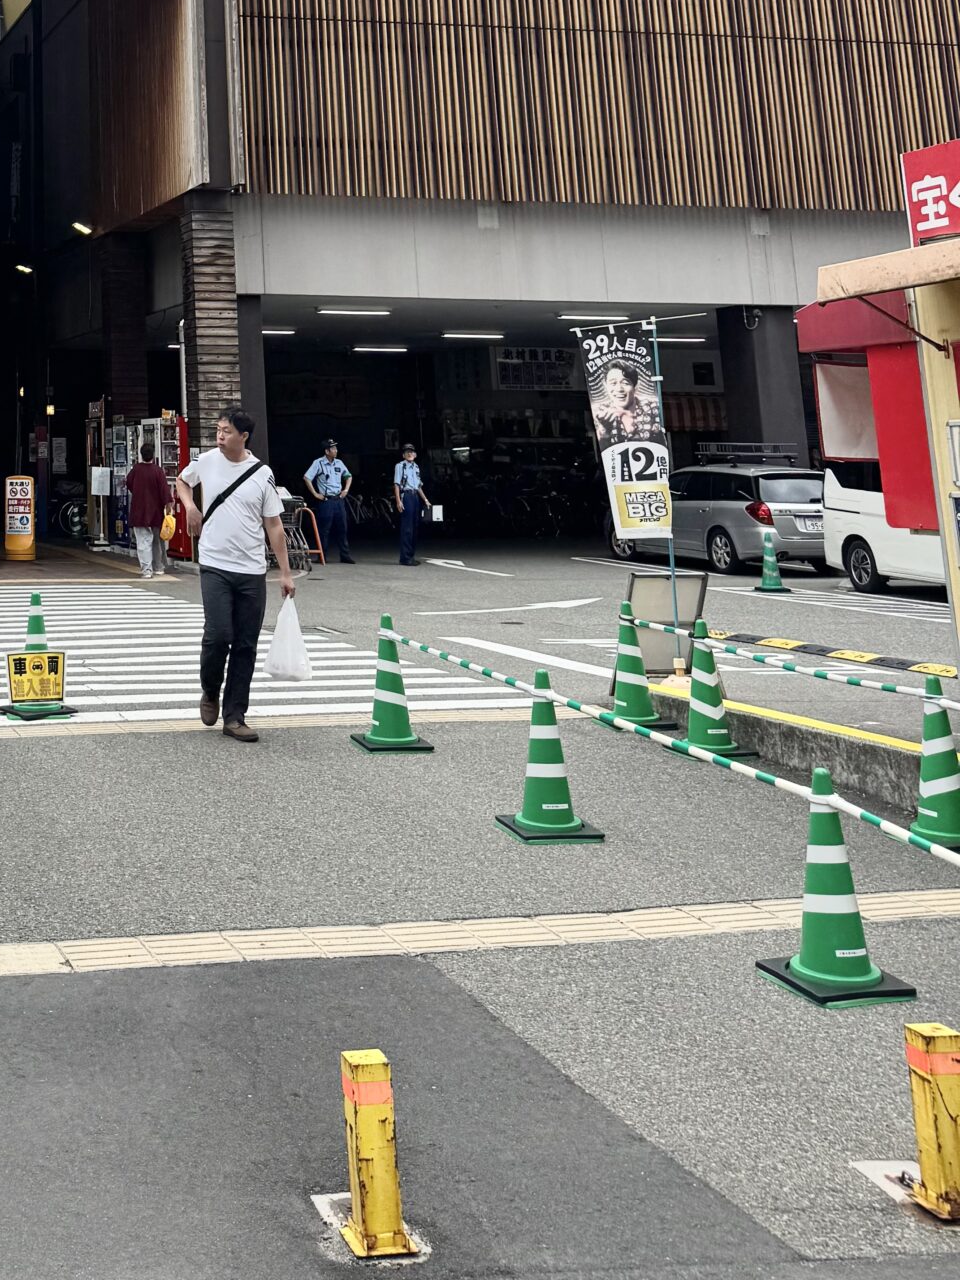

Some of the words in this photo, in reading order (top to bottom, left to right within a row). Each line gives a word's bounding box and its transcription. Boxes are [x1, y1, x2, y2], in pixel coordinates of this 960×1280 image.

[582, 334, 647, 360] 29人目の
[617, 446, 658, 482] 12
[623, 490, 667, 503] MEGA
[626, 501, 669, 519] BIG
[13, 677, 61, 698] 進入禁止
